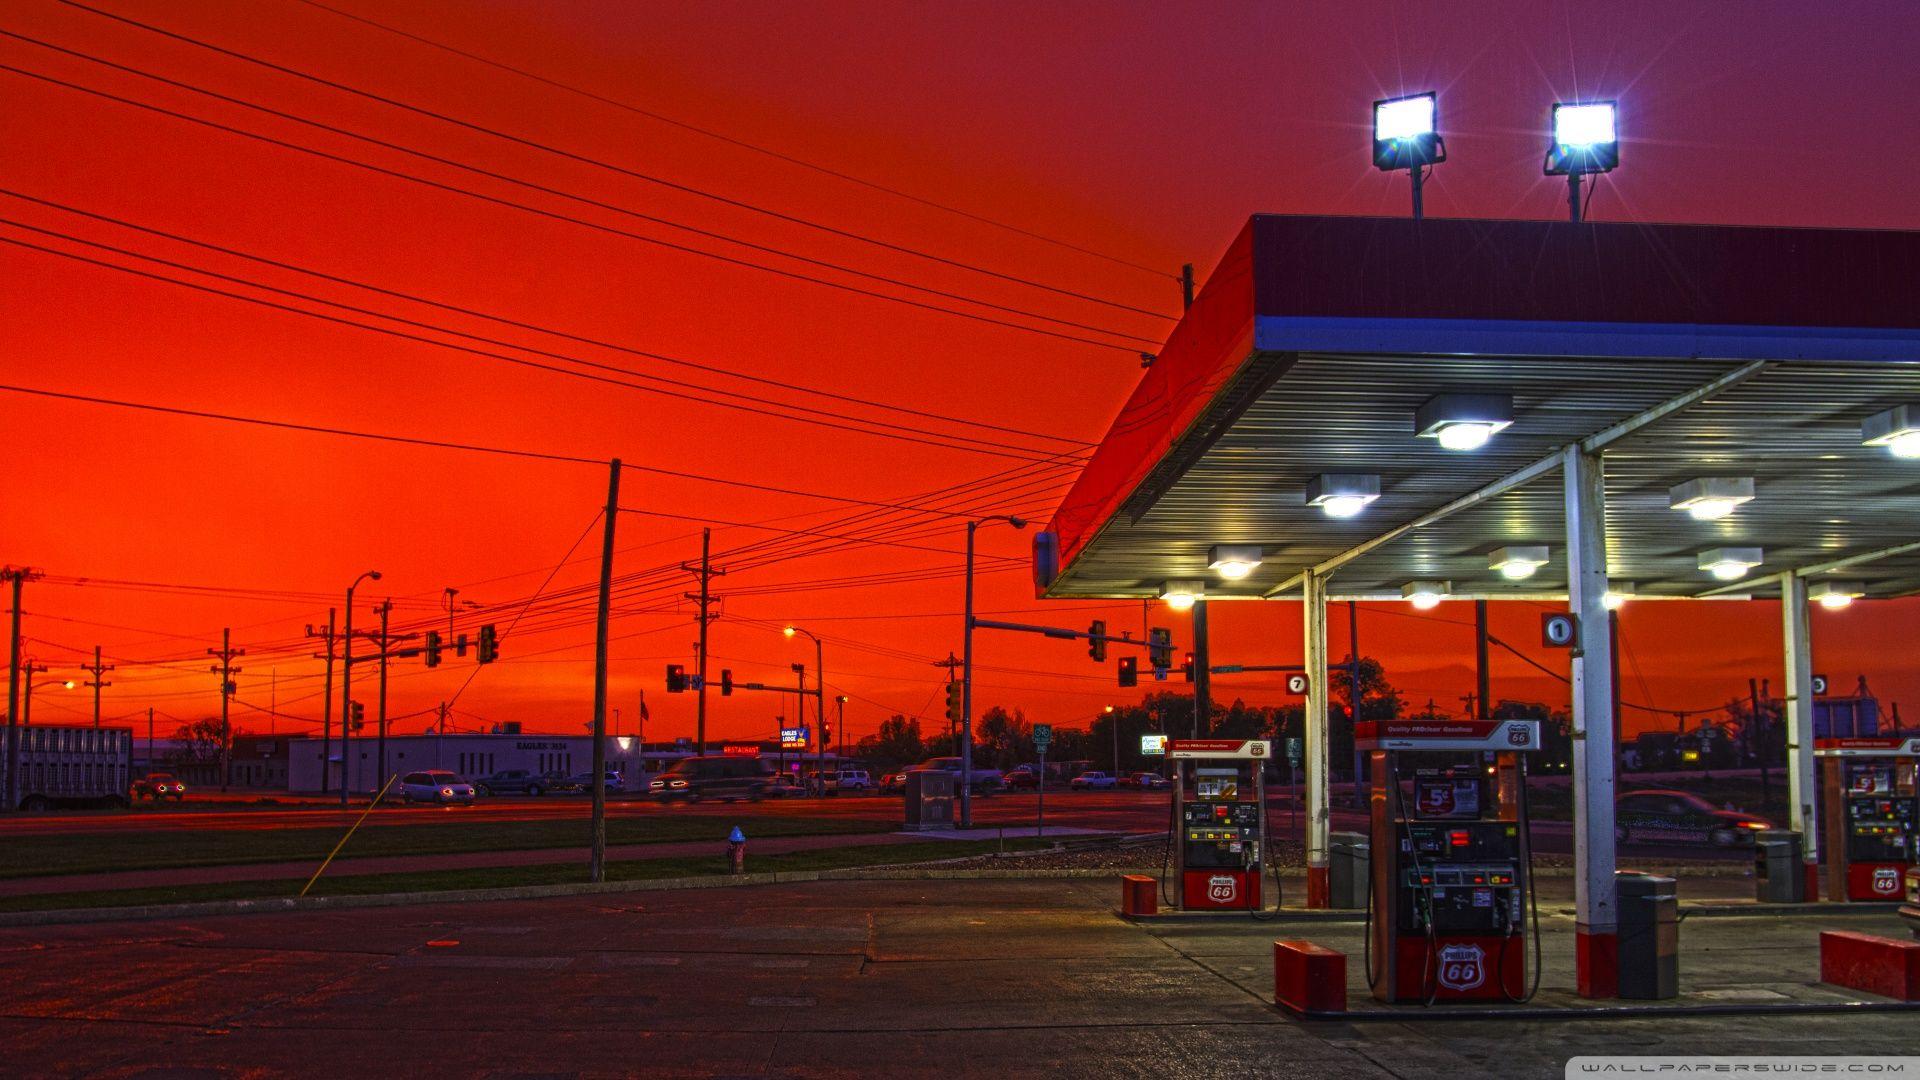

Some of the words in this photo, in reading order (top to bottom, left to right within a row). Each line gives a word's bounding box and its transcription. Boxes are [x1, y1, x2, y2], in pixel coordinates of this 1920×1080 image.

[1554, 622, 1563, 638] 1
[1293, 679, 1301, 689] 7
[1388, 726, 1410, 734] Quality
[1512, 733, 1526, 742] 66
[1877, 879, 1893, 888] 66
[1213, 886, 1231, 897] 66
[1445, 951, 1478, 960] PHILLIPS
[1448, 964, 1475, 980] 66
